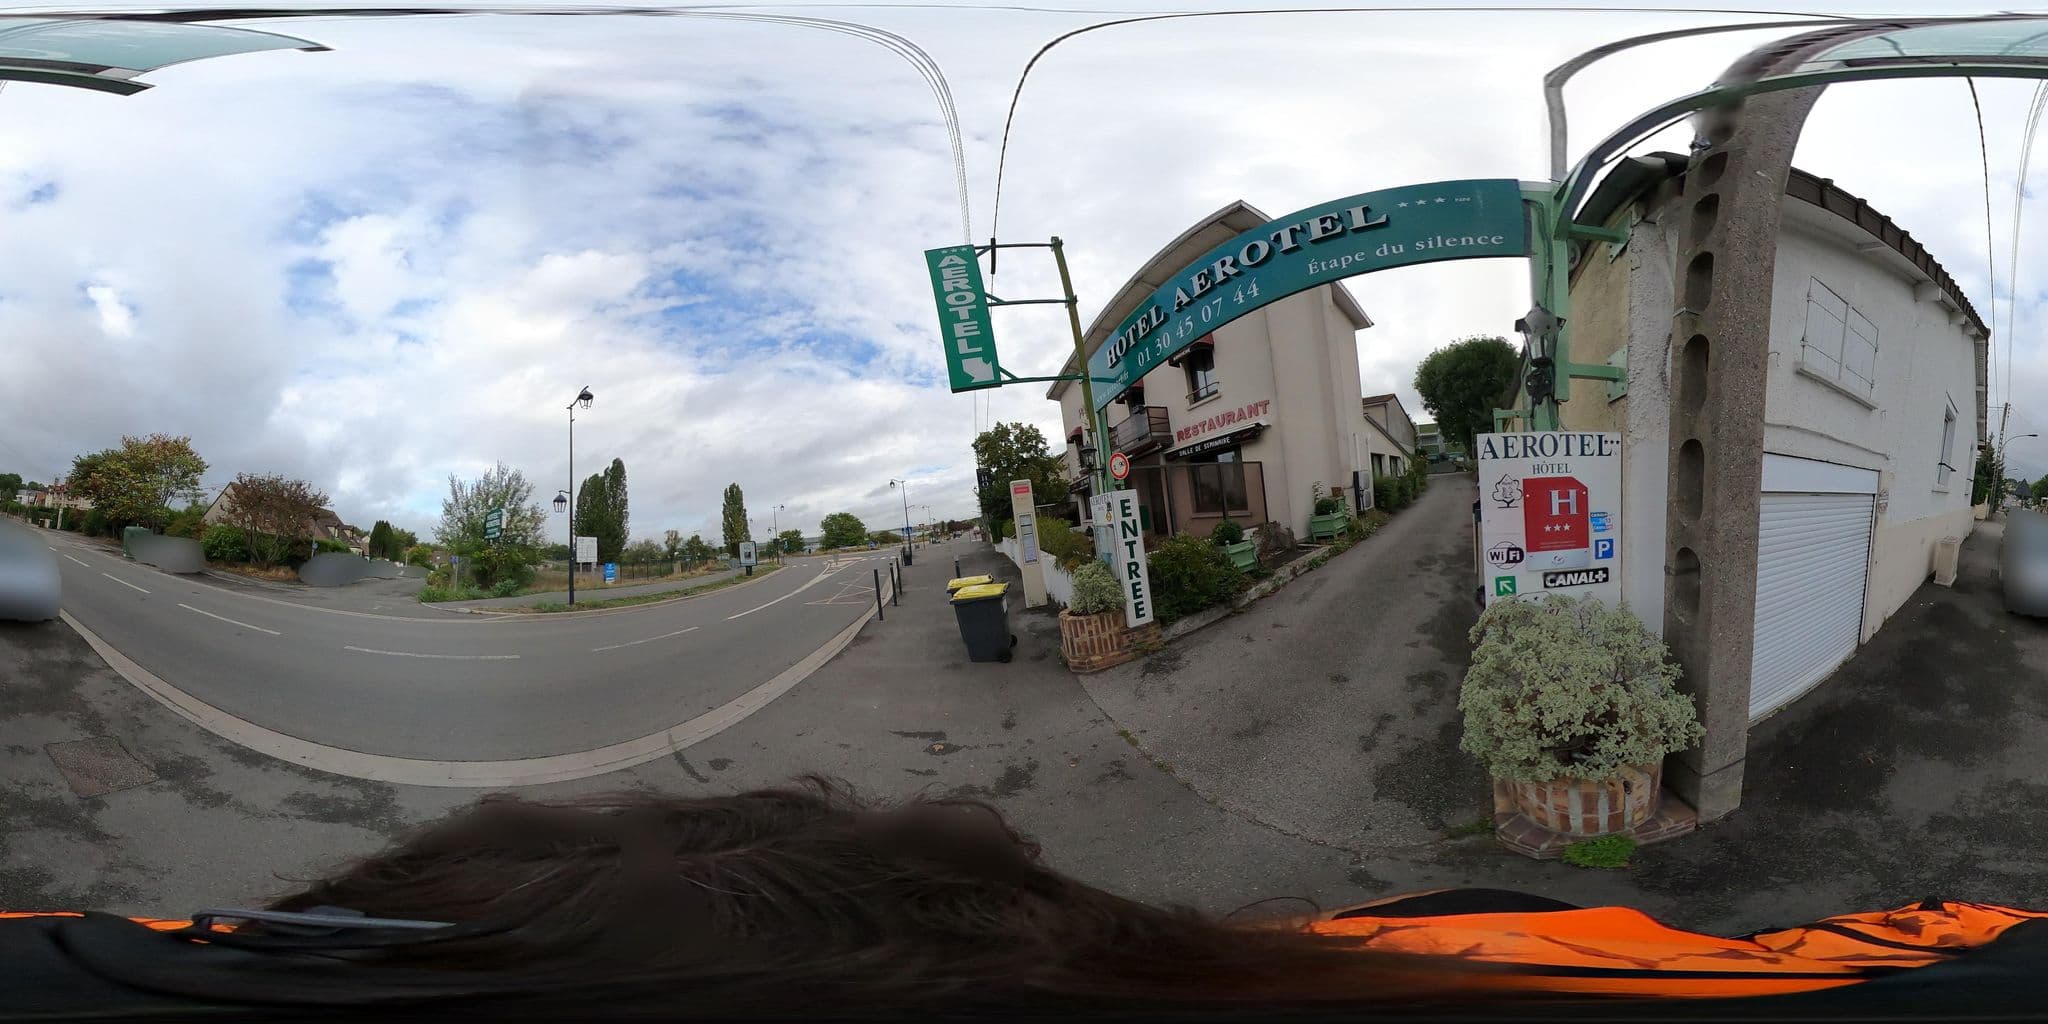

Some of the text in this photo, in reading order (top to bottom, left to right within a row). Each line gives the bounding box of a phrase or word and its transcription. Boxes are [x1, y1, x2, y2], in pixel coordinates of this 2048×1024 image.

[1308, 235, 1504, 275] Étape du silence
[938, 254, 983, 355] AEROTEL
[1106, 205, 1388, 368] HOTEL AEROTEL
[1138, 347, 1151, 367] 01
[1156, 332, 1171, 356] 30
[1176, 315, 1194, 339] 45
[1201, 297, 1223, 323] 07
[1233, 277, 1259, 305] 44
[1176, 400, 1270, 442] RESTAURANT
[1481, 434, 1613, 460] AEROTEL
[1550, 488, 1580, 516] H
[1120, 498, 1146, 619] ENTREE
[1598, 540, 1610, 558] P
[1545, 571, 1607, 587] CANAL+
